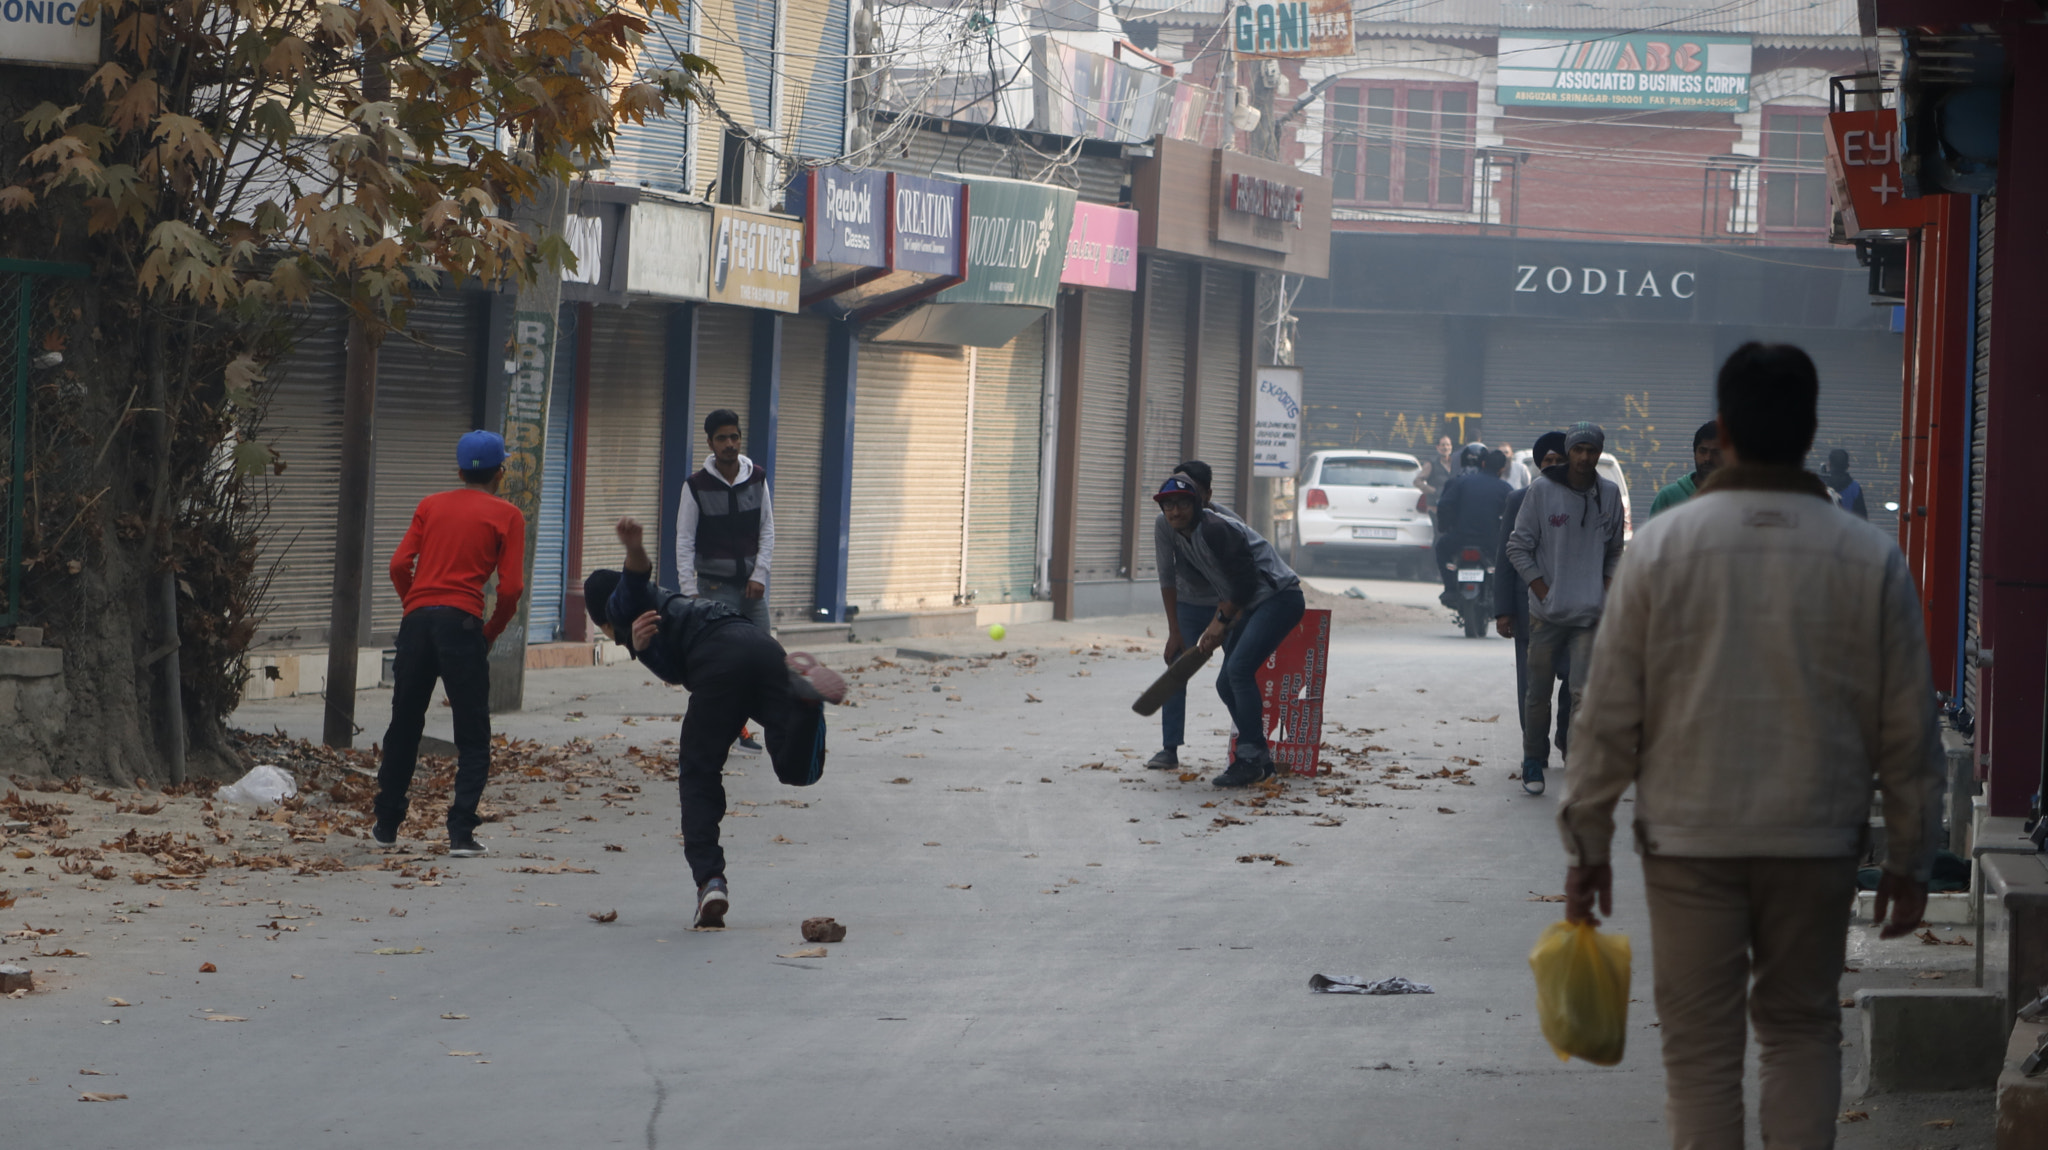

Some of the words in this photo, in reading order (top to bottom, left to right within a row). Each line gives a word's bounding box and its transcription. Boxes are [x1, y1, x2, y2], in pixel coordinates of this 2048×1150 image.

[0, 0, 95, 27] ONICS
[1236, 2, 1309, 52] GANI
[1616, 41, 1702, 72] ABC
[1556, 71, 1635, 91] ASSOCIATED
[1639, 74, 1702, 93] BUSINESS
[1705, 77, 1748, 95] CORPN.
[1843, 130, 1901, 166] EY
[826, 178, 870, 229] Reebok
[896, 188, 954, 238] CREATION
[730, 218, 801, 280] FEATURES
[844, 227, 870, 250] Classics
[968, 216, 1037, 269] WOODLAND
[1515, 265, 1695, 298] ZODIAC
[1260, 380, 1299, 419] EXPORTS
[1288, 711, 1299, 744] Honey
